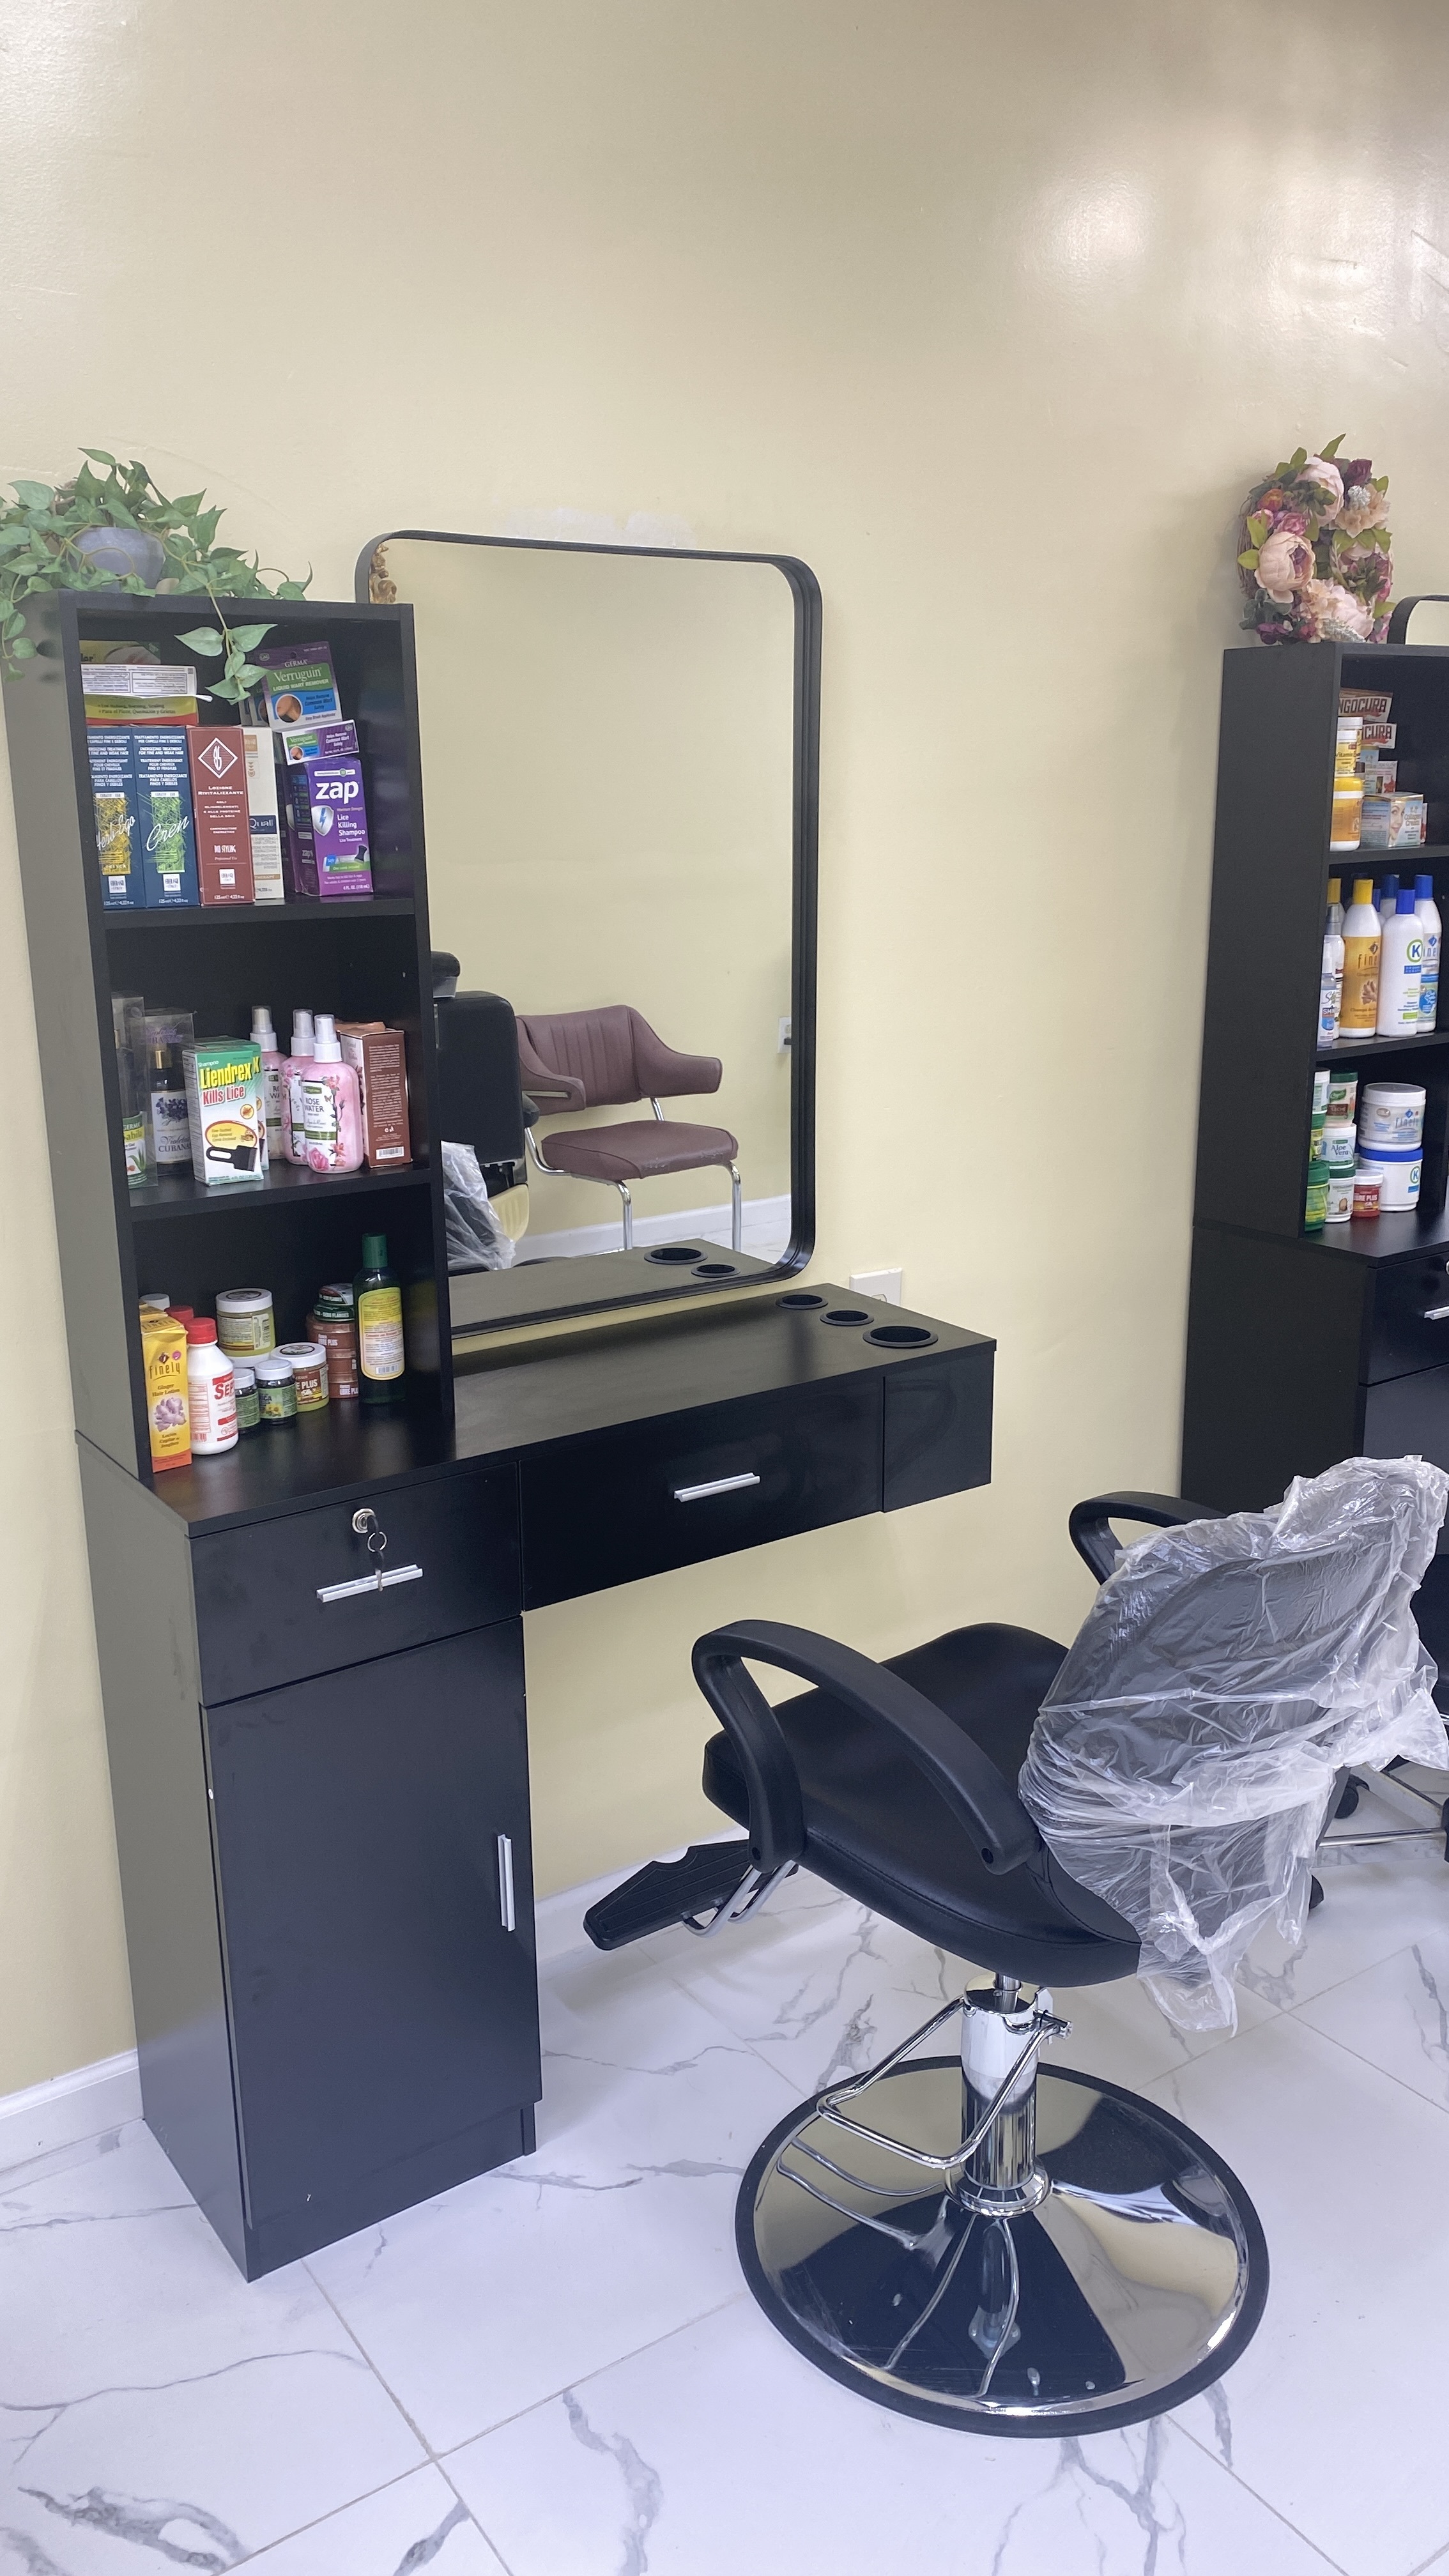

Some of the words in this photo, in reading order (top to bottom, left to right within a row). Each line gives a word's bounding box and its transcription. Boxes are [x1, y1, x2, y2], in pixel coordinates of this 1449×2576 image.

[273, 667, 321, 682] Verruguin
[315, 781, 359, 804] zap
[1412, 944, 1420, 958] K
[1358, 954, 1377, 969] fine
[199, 1062, 252, 1089] Liendrex
[203, 1088, 224, 1105] Kills
[226, 1085, 245, 1101] Lice
[1413, 1170, 1419, 1181] K
[149, 1361, 181, 1379] finely
[302, 1379, 318, 1389] PLUS
